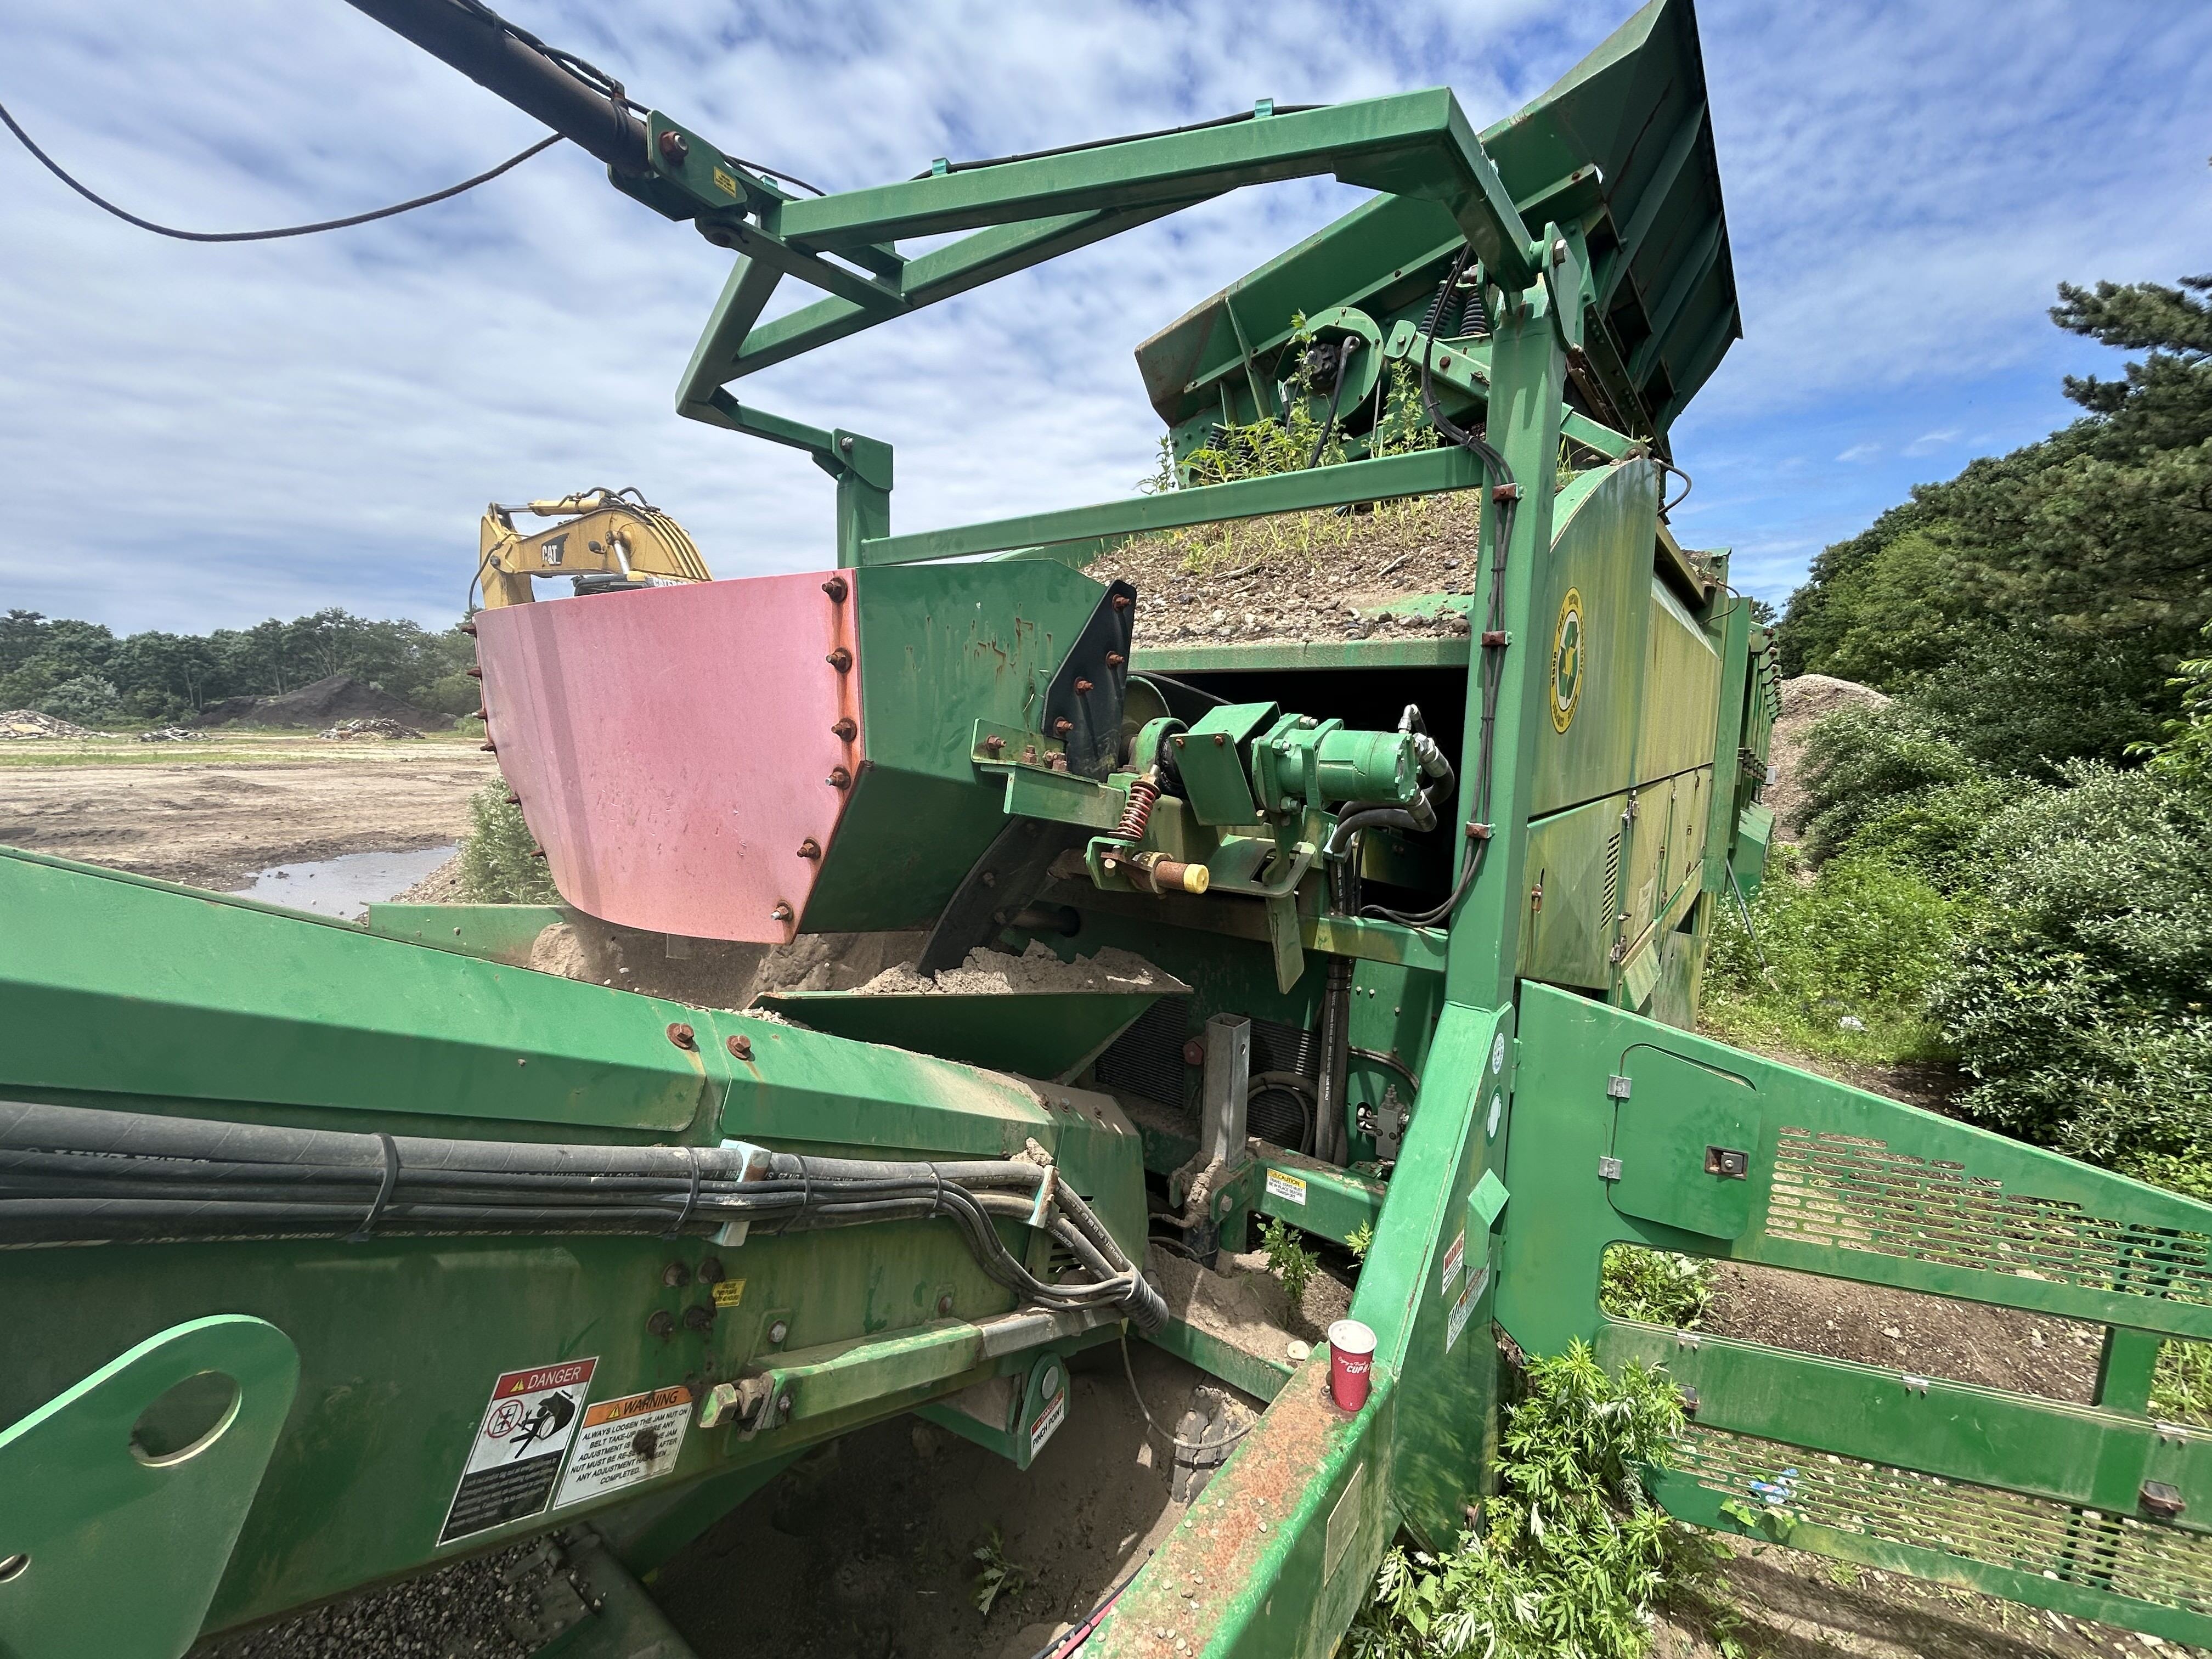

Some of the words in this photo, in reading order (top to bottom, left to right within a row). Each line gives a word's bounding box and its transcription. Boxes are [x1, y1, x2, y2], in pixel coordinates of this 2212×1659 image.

[542, 545, 557, 564] CAT
[1278, 1174, 1300, 1186] CAUTION
[527, 1366, 582, 1390] DANGER
[623, 1391, 679, 1415] WARNING
[582, 1427, 611, 1440] ALWAYS
[612, 1421, 638, 1433] LOOSEN
[640, 1417, 652, 1426] THE
[652, 1414, 665, 1423] JAM
[665, 1410, 678, 1420] NUT
[589, 1438, 607, 1449] BELT
[608, 1431, 636, 1443] TAKE-UP
[662, 1420, 675, 1429] ANY
[1032, 1426, 1048, 1449] PINCH
[1048, 1404, 1063, 1431] POINT
[571, 1465, 586, 1474] NUT
[586, 1459, 607, 1470] MUST
[658, 1437, 678, 1448] AFTER
[578, 1443, 623, 1462] ADJUSTMENT
[665, 1429, 678, 1438] JAM
[575, 1472, 591, 1482] ANY
[591, 1459, 635, 1477] ADJUSTMENT
[600, 1466, 640, 1485] COMPLETED.
